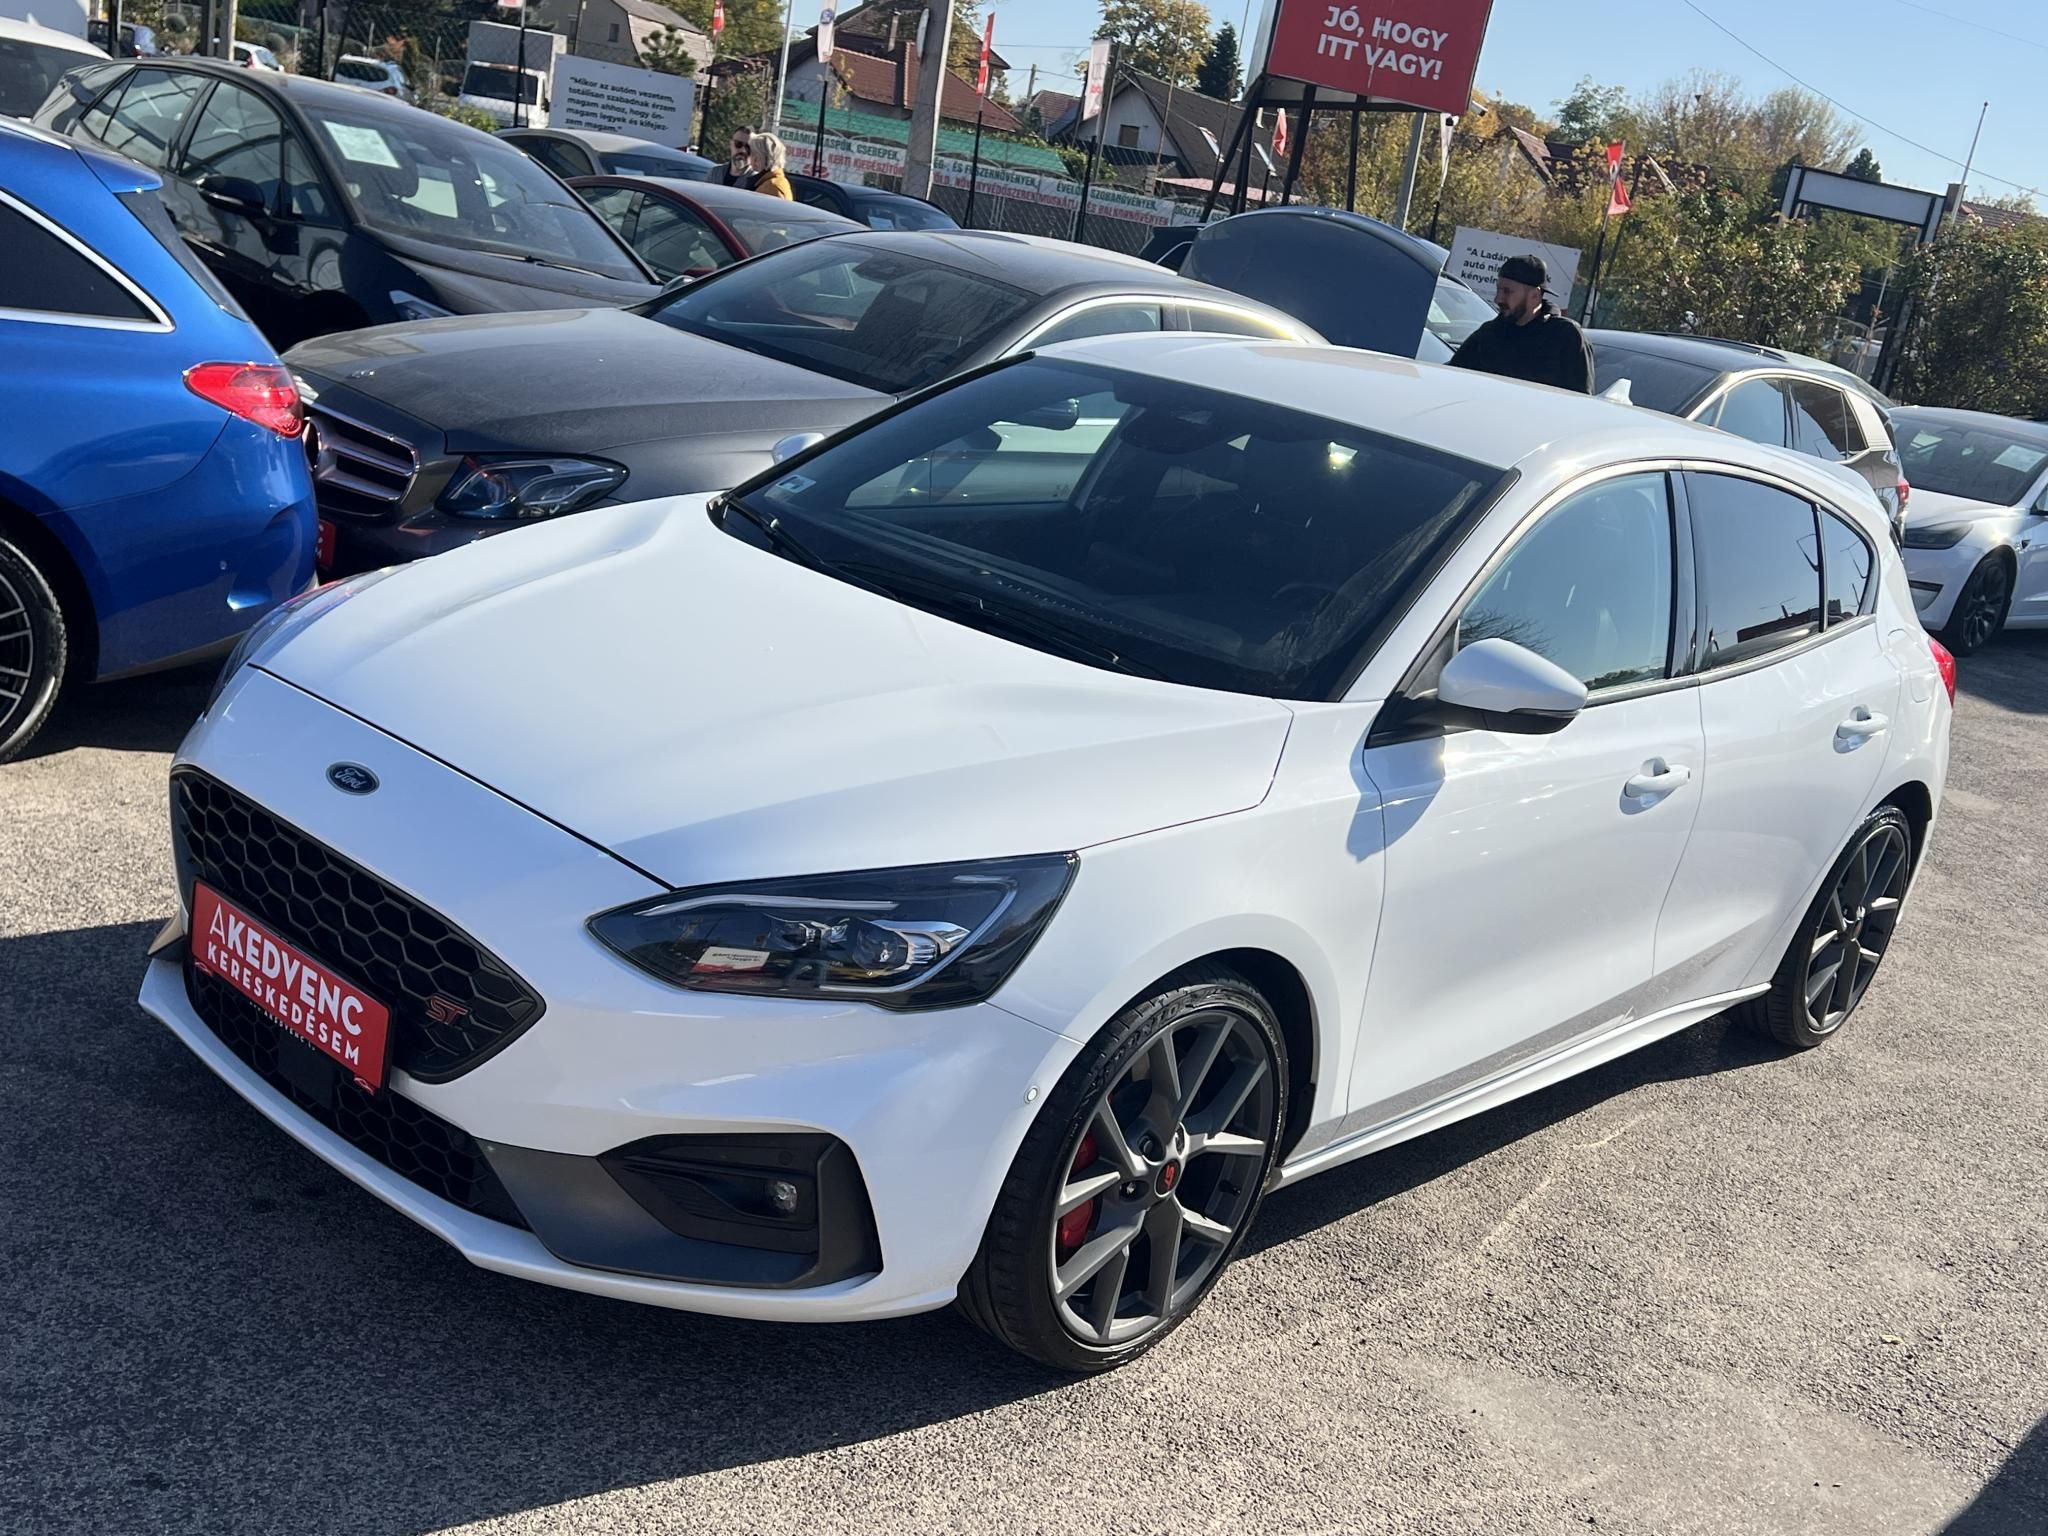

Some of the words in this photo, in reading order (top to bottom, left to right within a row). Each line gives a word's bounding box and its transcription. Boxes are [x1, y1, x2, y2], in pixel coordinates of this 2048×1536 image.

[1323, 5, 1365, 38] JÓ,
[1371, 16, 1449, 52] HOGY
[1317, 33, 1359, 61] ITT
[1364, 43, 1443, 81] VAGY!
[629, 107, 649, 119] hogy
[1463, 259, 1486, 270] autó
[1480, 249, 1510, 262] Ladán
[335, 767, 367, 789] Ford
[209, 902, 365, 1036] AKEDVENC
[207, 940, 360, 1066] KERESKEDÉSEM
[425, 994, 469, 1026] ST
